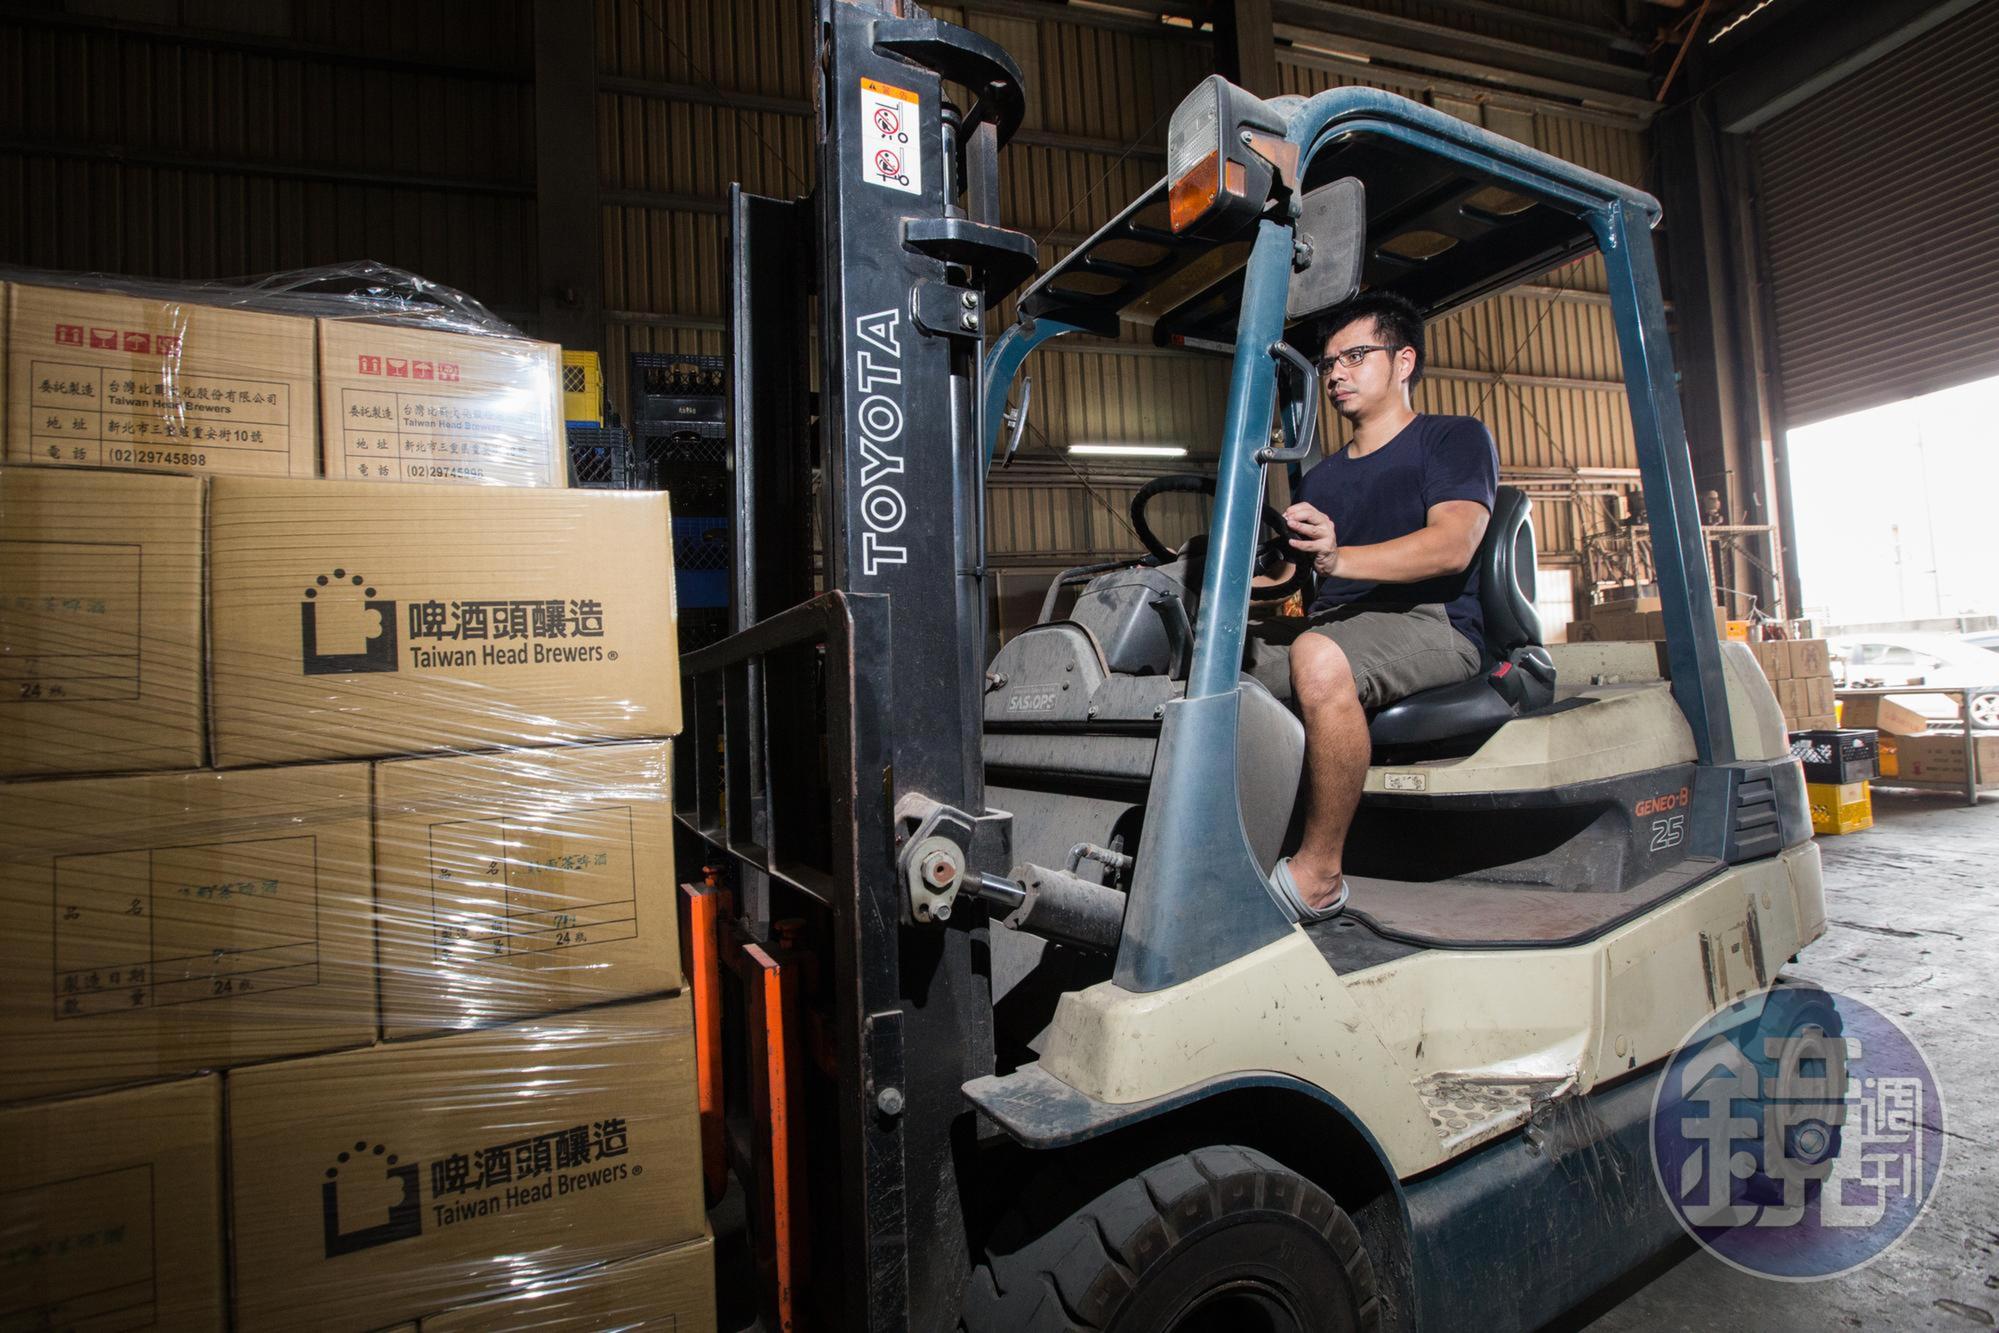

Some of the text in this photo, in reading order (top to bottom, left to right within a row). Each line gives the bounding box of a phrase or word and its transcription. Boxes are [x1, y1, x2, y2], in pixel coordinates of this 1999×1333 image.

[38, 380, 95, 397] 委託製造
[108, 395, 149, 408] Taiwan
[186, 401, 232, 414] Brewers
[350, 405, 393, 420] 委託製造
[46, 416, 88, 430] 地址
[403, 418, 436, 428] Taiwan
[356, 438, 389, 450] 地址
[857, 309, 907, 575] TOYOTA
[48, 445, 87, 460] 電話
[109, 448, 206, 466] (02)29745898
[358, 463, 390, 477] 電話
[409, 600, 604, 641] 啤酒頭釀造
[410, 643, 603, 668] Taiwan Head Brewers
[1650, 815, 1684, 852] 25
[556, 933, 571, 946] 24
[213, 980, 233, 995] 24
[431, 1118, 629, 1199] 啤酒頭釀造
[433, 1163, 628, 1228] Taiwan Head Brewers
